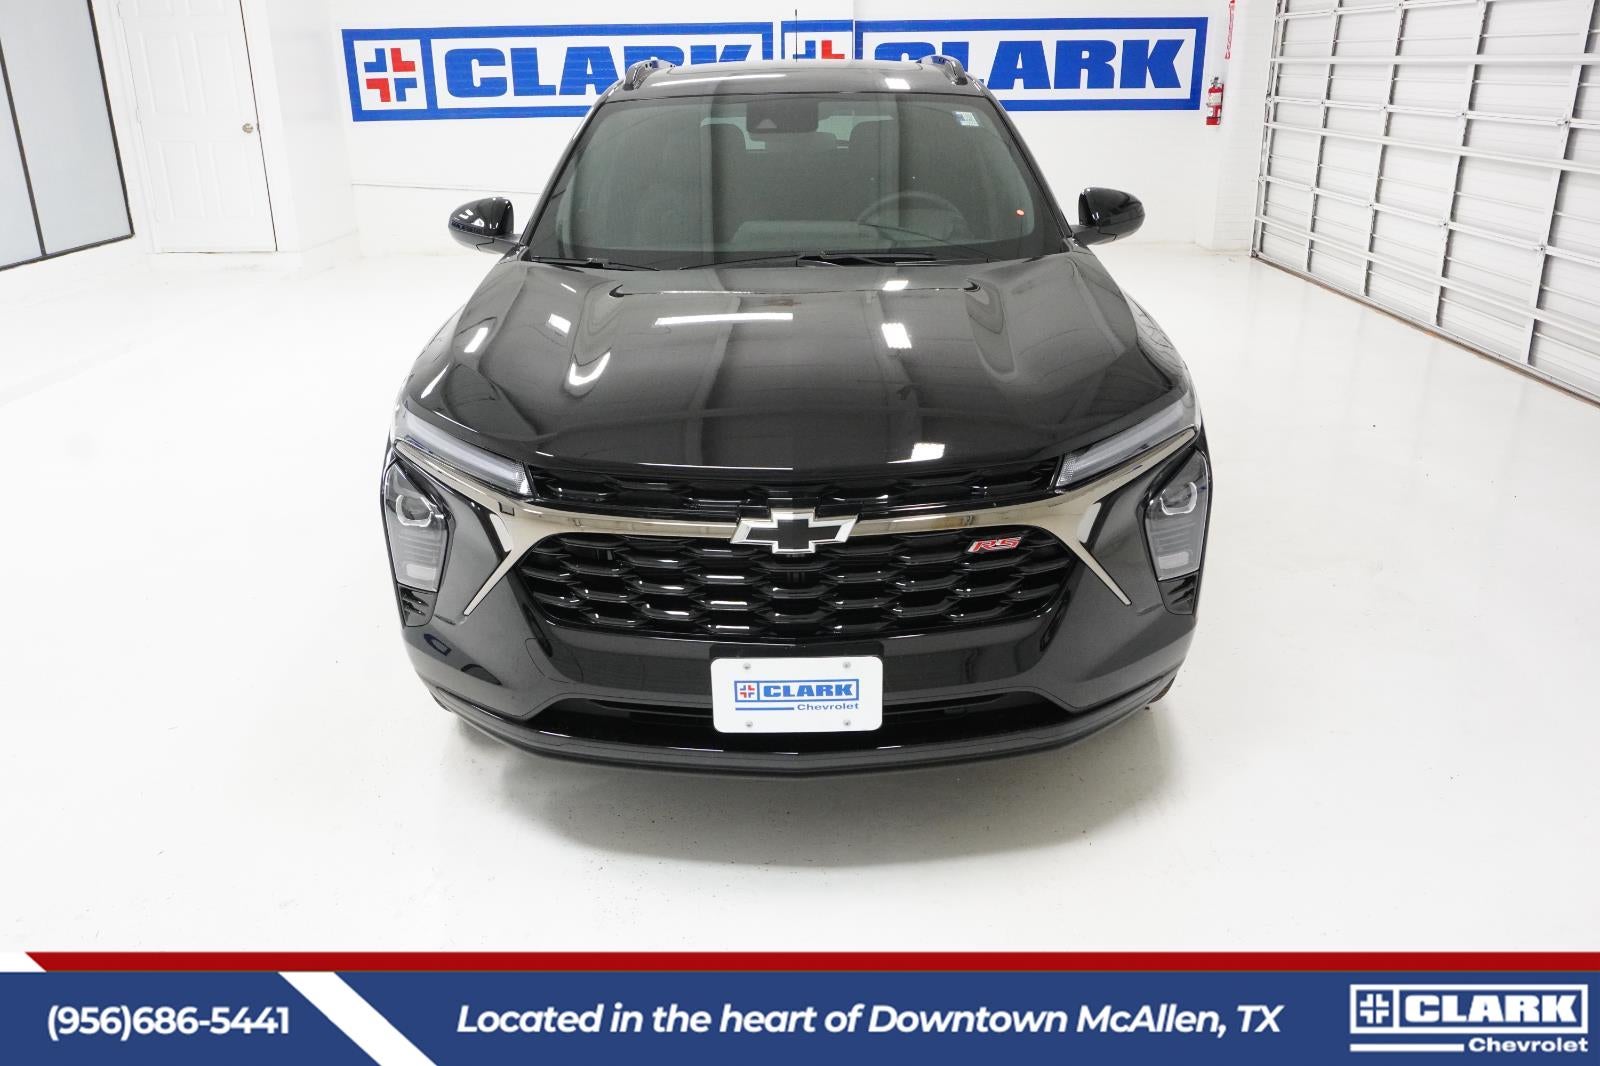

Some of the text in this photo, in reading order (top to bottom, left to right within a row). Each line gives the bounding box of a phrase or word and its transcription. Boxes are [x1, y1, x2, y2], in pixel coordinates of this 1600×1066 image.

[968, 537, 1022, 553] RS
[763, 683, 853, 698] CLARK
[796, 702, 859, 711] Chevrolet
